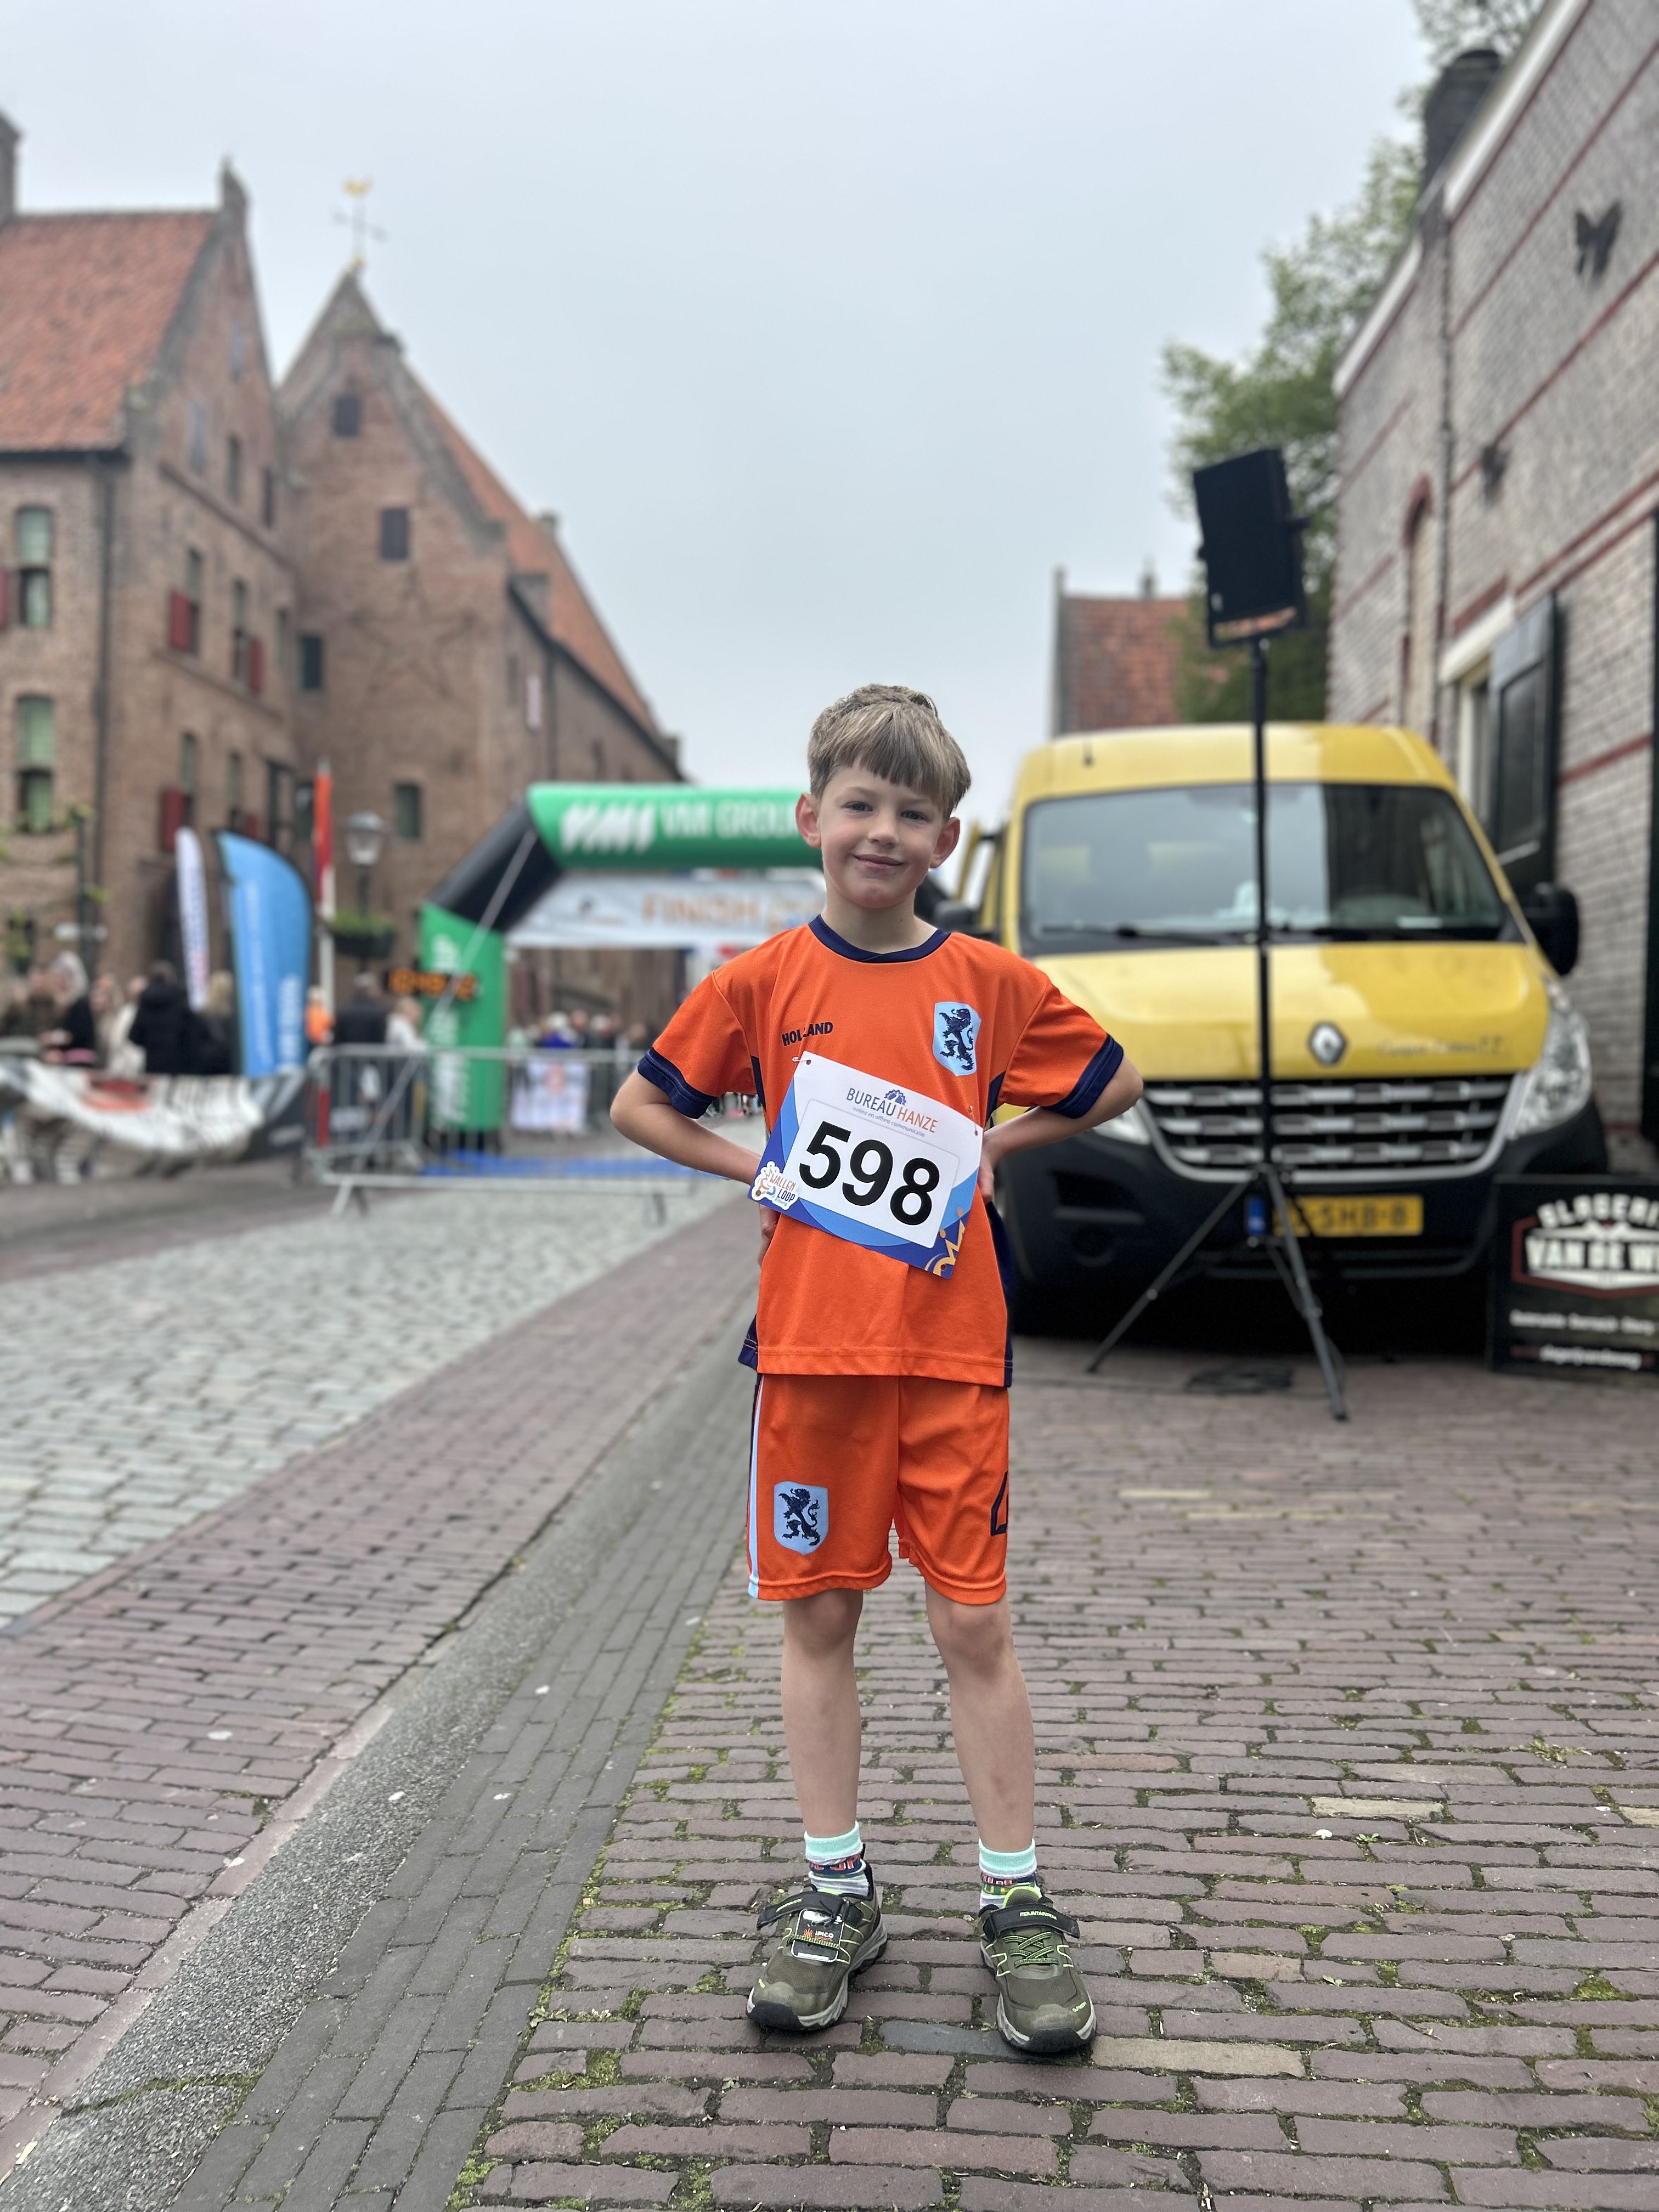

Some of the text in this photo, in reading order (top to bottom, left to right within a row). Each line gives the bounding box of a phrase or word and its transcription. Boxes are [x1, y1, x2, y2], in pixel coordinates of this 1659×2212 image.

[641, 892, 761, 928] FINISH
[846, 1087, 938, 1133] BUREAU HANZE
[853, 1107, 867, 1116] online
[891, 1121, 925, 1137] communicatie
[770, 1173, 796, 1192] WALLEN
[799, 1120, 940, 1226] 598
[777, 1188, 795, 1203] LOOP
[1526, 1235, 1585, 1269] VAN
